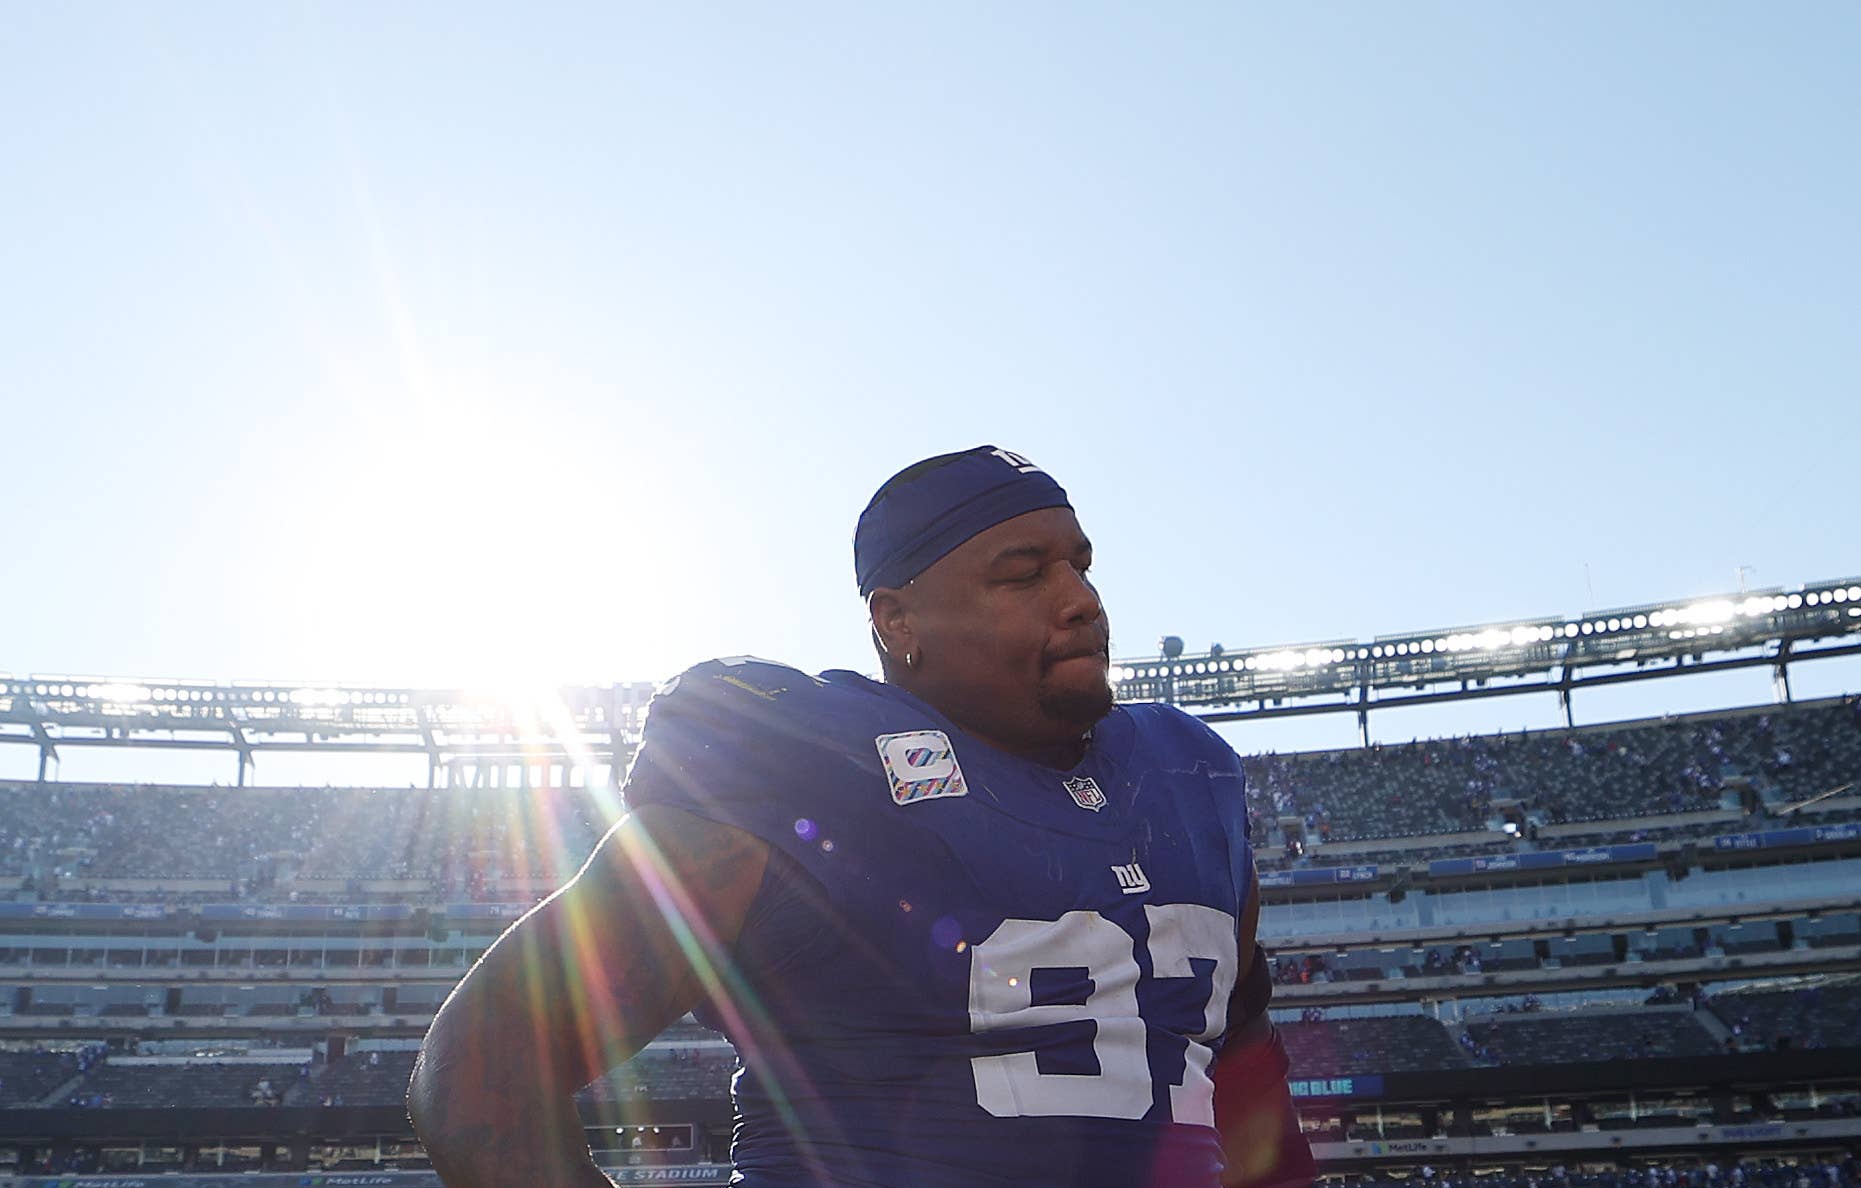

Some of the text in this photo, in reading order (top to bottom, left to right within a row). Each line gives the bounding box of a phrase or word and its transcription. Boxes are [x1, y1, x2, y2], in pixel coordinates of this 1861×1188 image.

[1074, 788, 1103, 805] NFL
[968, 903, 1237, 1126] 97
[1389, 1143, 1427, 1151] MetLife
[633, 1168, 718, 1180] STADIUM
[325, 1176, 393, 1185] MetLife
